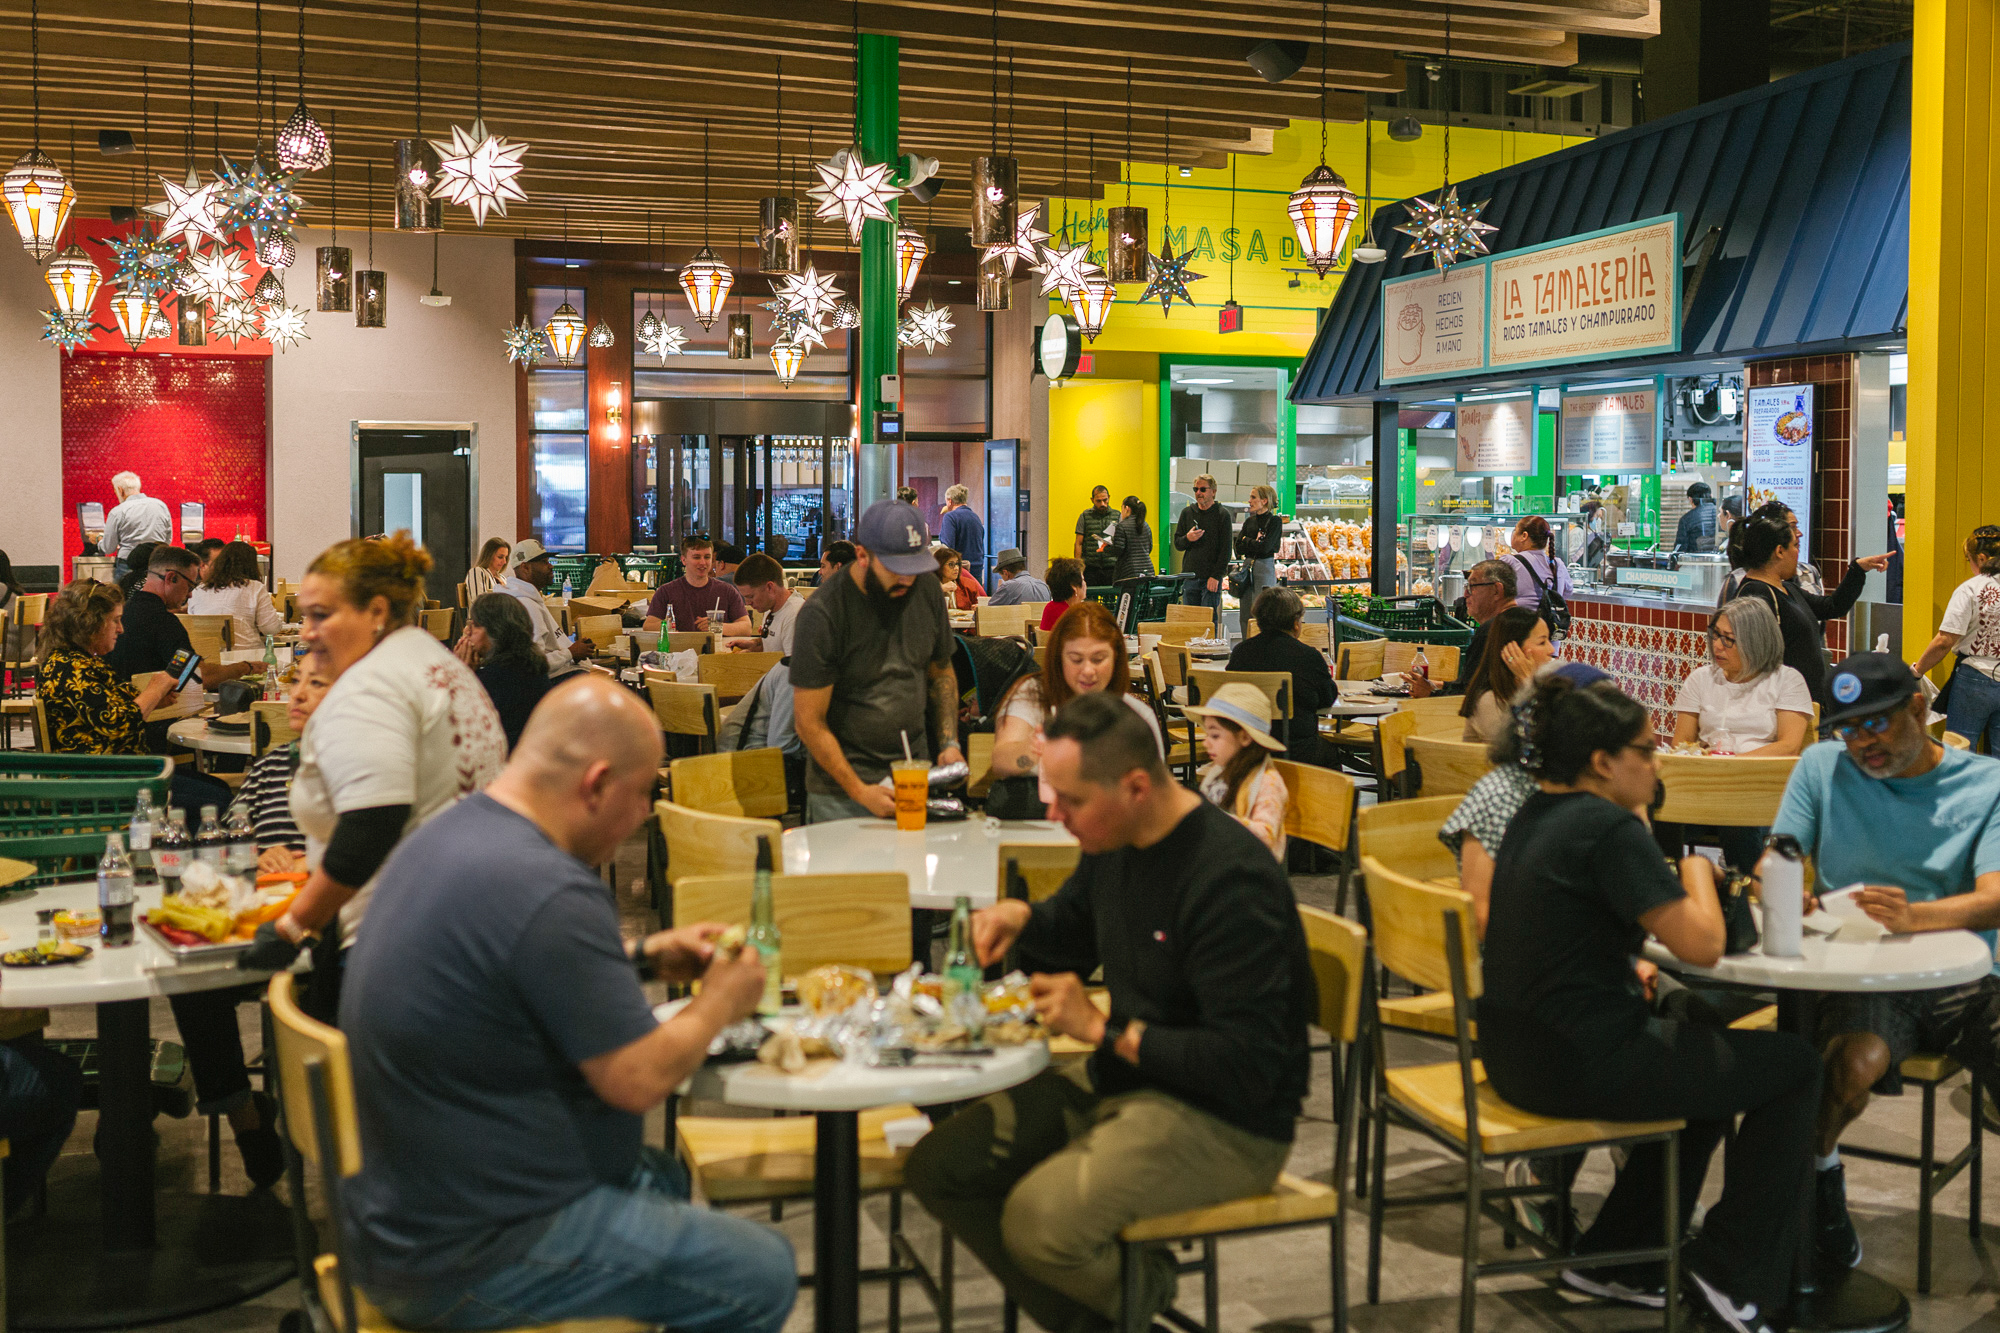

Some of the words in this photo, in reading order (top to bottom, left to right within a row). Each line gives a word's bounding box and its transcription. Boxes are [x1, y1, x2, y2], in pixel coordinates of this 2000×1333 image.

[1160, 225, 1269, 265] MASA
[1503, 279, 1524, 321] LA
[1533, 246, 1656, 315] TAMALERÍA
[1438, 291, 1462, 308] RECIEN
[1221, 309, 1238, 331] EXIT
[1435, 314, 1463, 331] HECHOS
[1503, 325, 1525, 341] RICOS
[1528, 318, 1568, 338] TAMALES
[1571, 317, 1578, 331] Y
[1580, 303, 1656, 330] CHAMPURRADO
[1436, 341, 1441, 354] A
[1441, 338, 1462, 354] MANO
[1076, 355, 1093, 373] XIT
[1570, 403, 1579, 412] THE
[1579, 402, 1597, 411] HISTORY
[1604, 394, 1645, 411] TAMALES
[1754, 398, 1780, 407] TAMALES
[1756, 477, 1779, 486] TAMALES
[905, 525, 922, 547] LA
[1625, 572, 1678, 585] CHAMPURRADO
